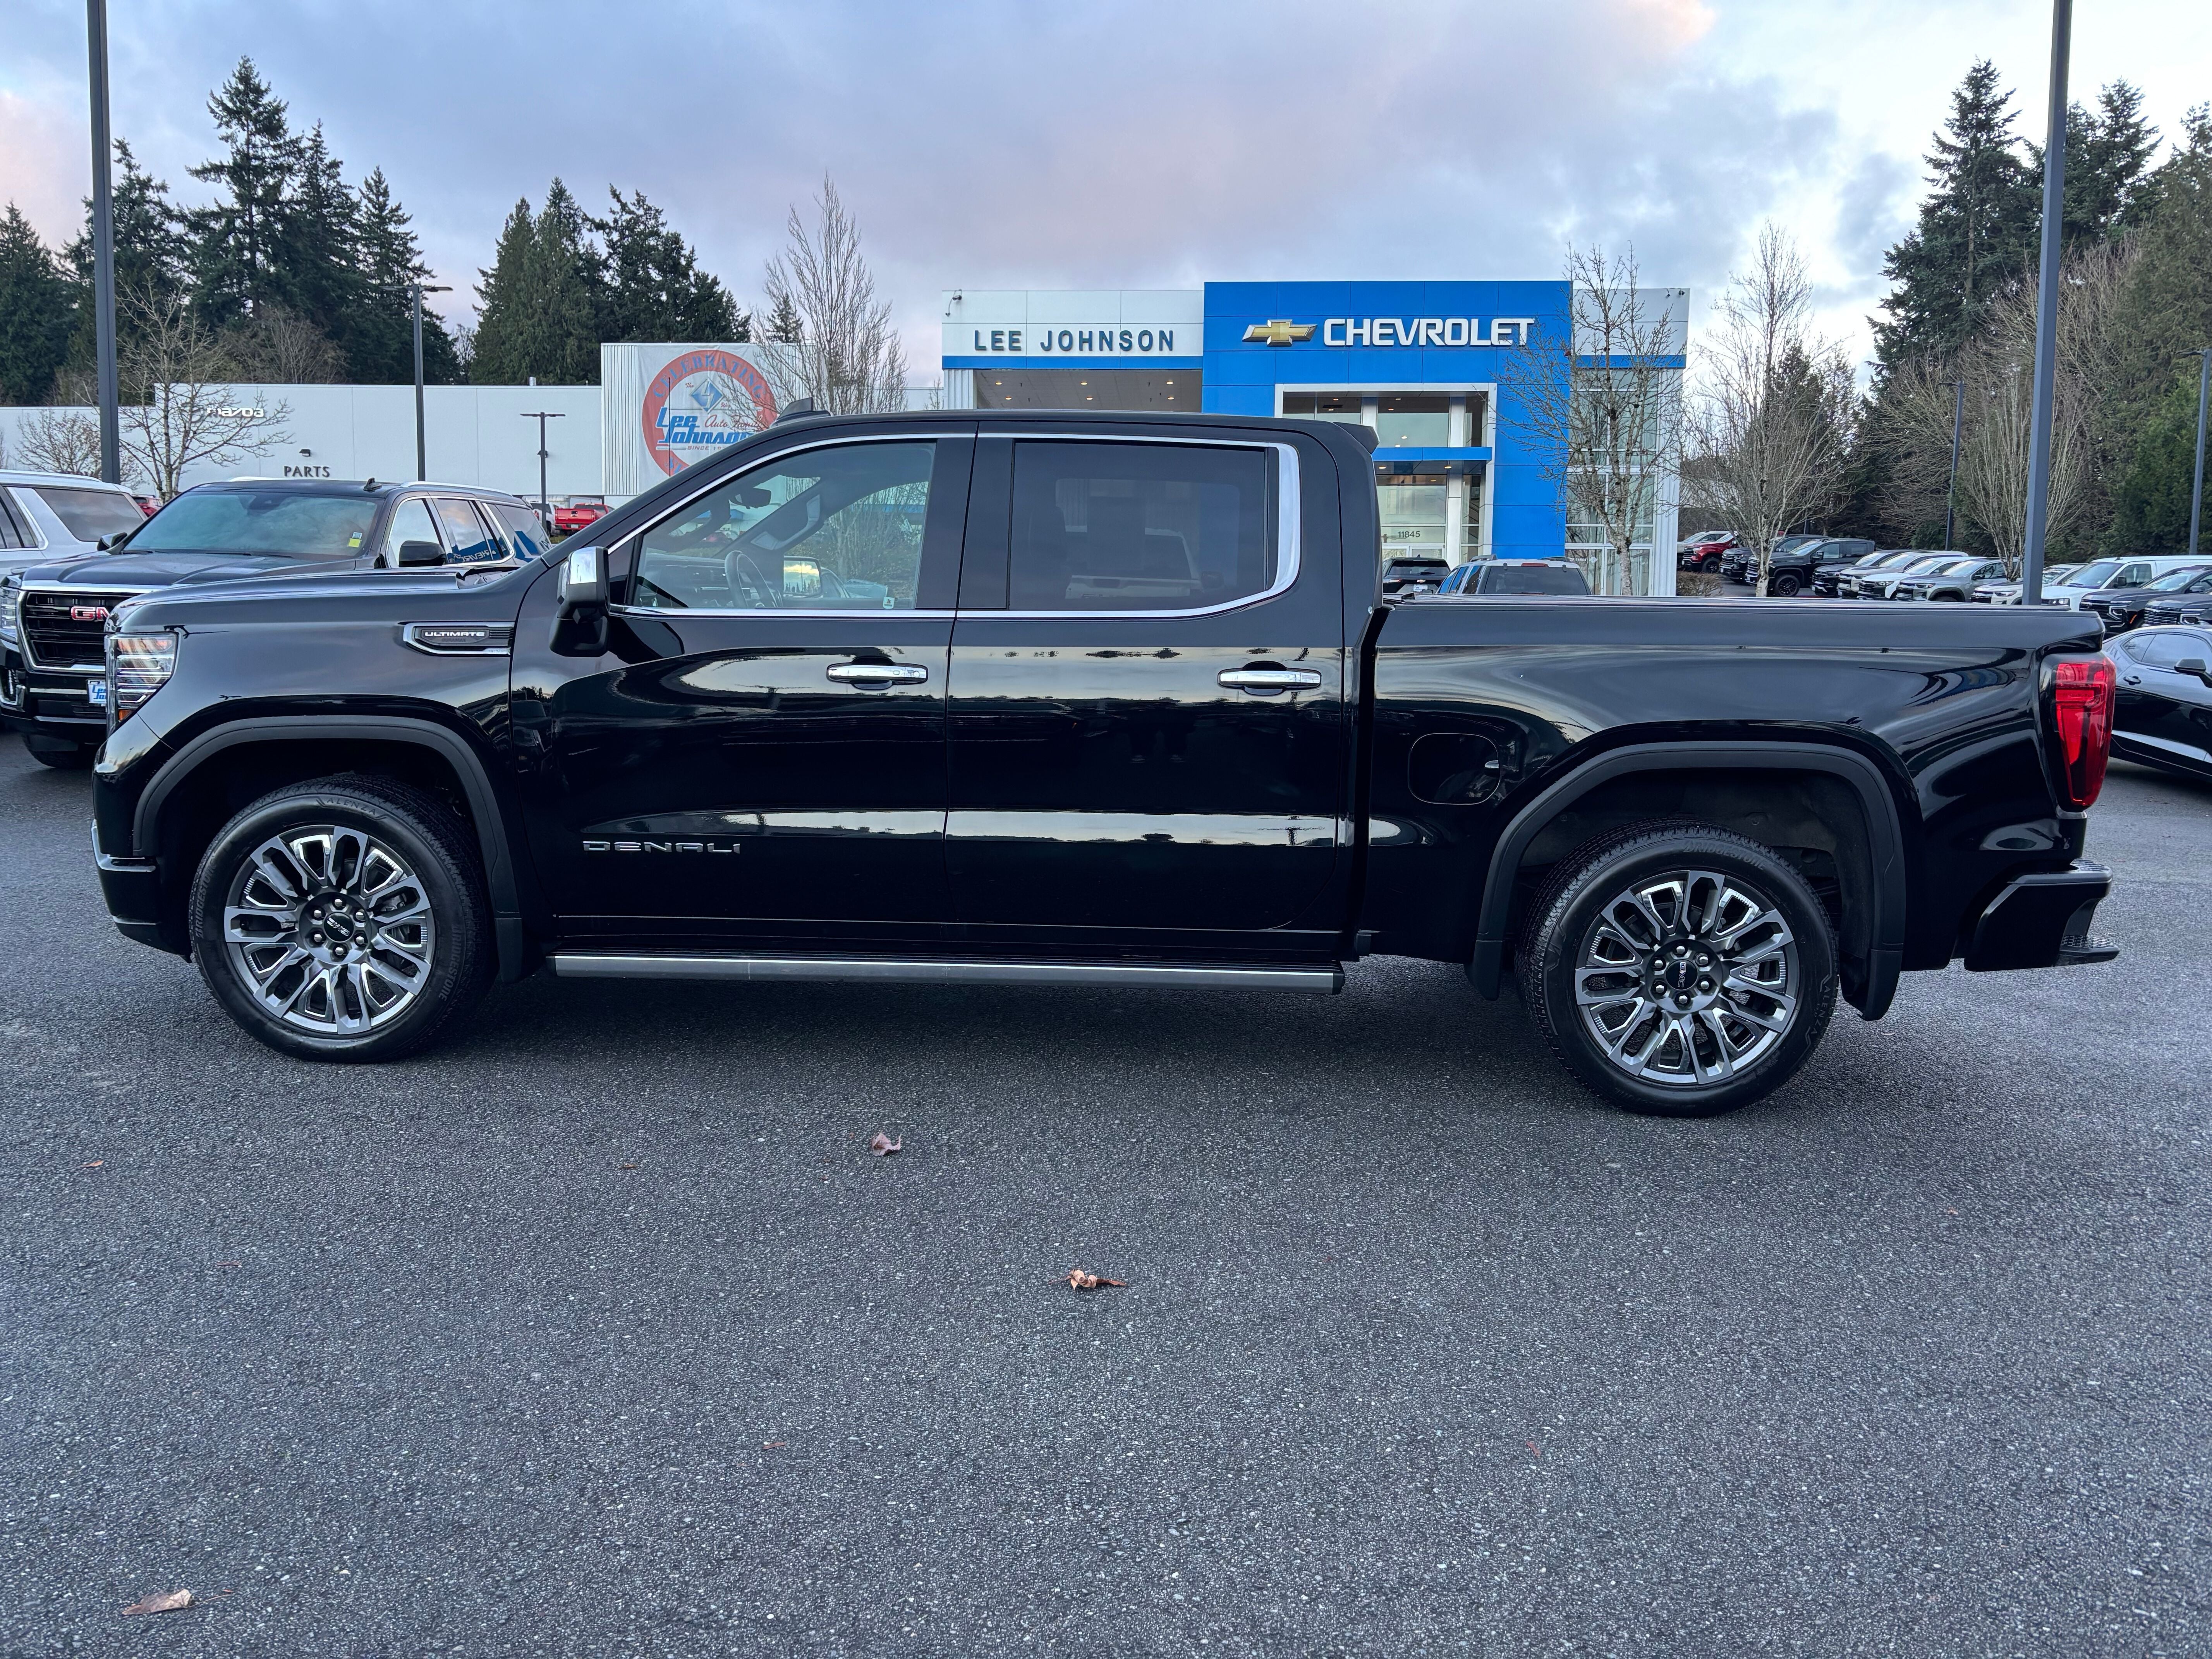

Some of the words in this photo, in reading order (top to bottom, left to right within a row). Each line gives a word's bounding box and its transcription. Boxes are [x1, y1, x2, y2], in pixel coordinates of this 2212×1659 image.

[974, 330, 1022, 351] LEE
[1040, 330, 1174, 351] JOHNSON
[1324, 318, 1535, 345] CHEVROLET
[653, 354, 767, 398] CELEBRATING
[656, 407, 699, 428] Lee
[705, 414, 728, 428] Auto
[284, 466, 330, 477] PARTS
[327, 797, 376, 815] ALENZA
[583, 841, 740, 854] DENALI
[1683, 839, 1765, 870] BRIDGESTONE
[327, 917, 350, 936] GMC
[1678, 962, 1686, 988] GMC
[1810, 985, 1831, 1034] ALENZA
